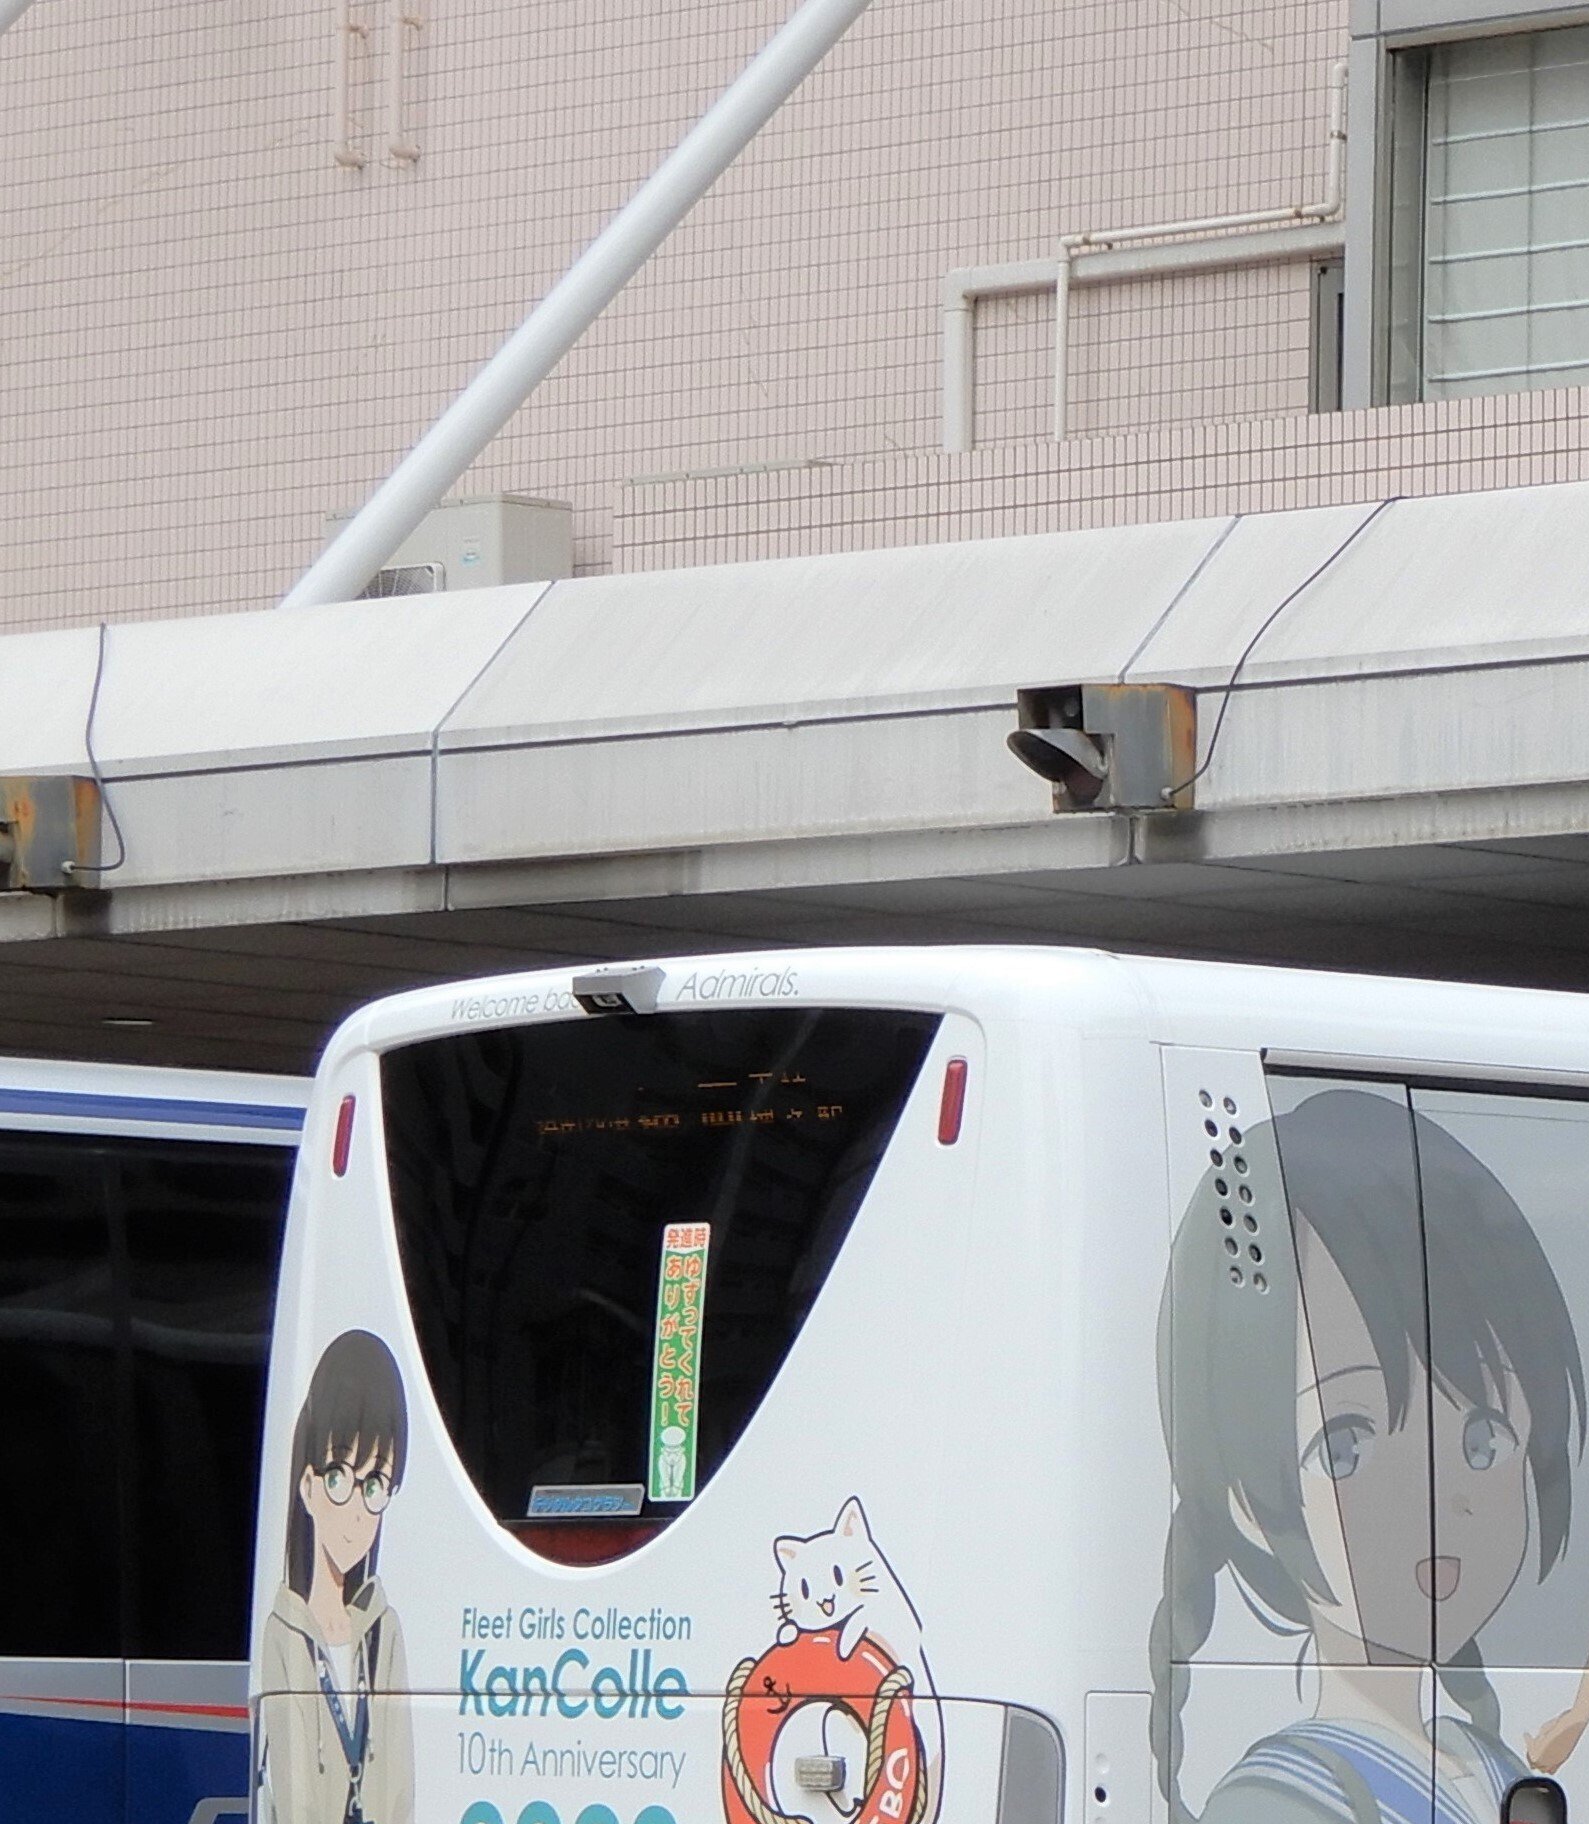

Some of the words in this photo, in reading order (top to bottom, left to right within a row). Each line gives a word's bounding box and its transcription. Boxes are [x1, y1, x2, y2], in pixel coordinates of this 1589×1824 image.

[450, 996, 537, 1020] Welcome
[677, 966, 800, 1001] Admirals.
[675, 1254, 702, 1427] ゆずってくれて
[462, 1607, 512, 1639] Fleet
[519, 1607, 566, 1639] Girls
[573, 1607, 692, 1640] Collection
[459, 1648, 690, 1720] KanColle
[458, 1731, 513, 1776] 10th
[520, 1739, 686, 1789] Anniversary
